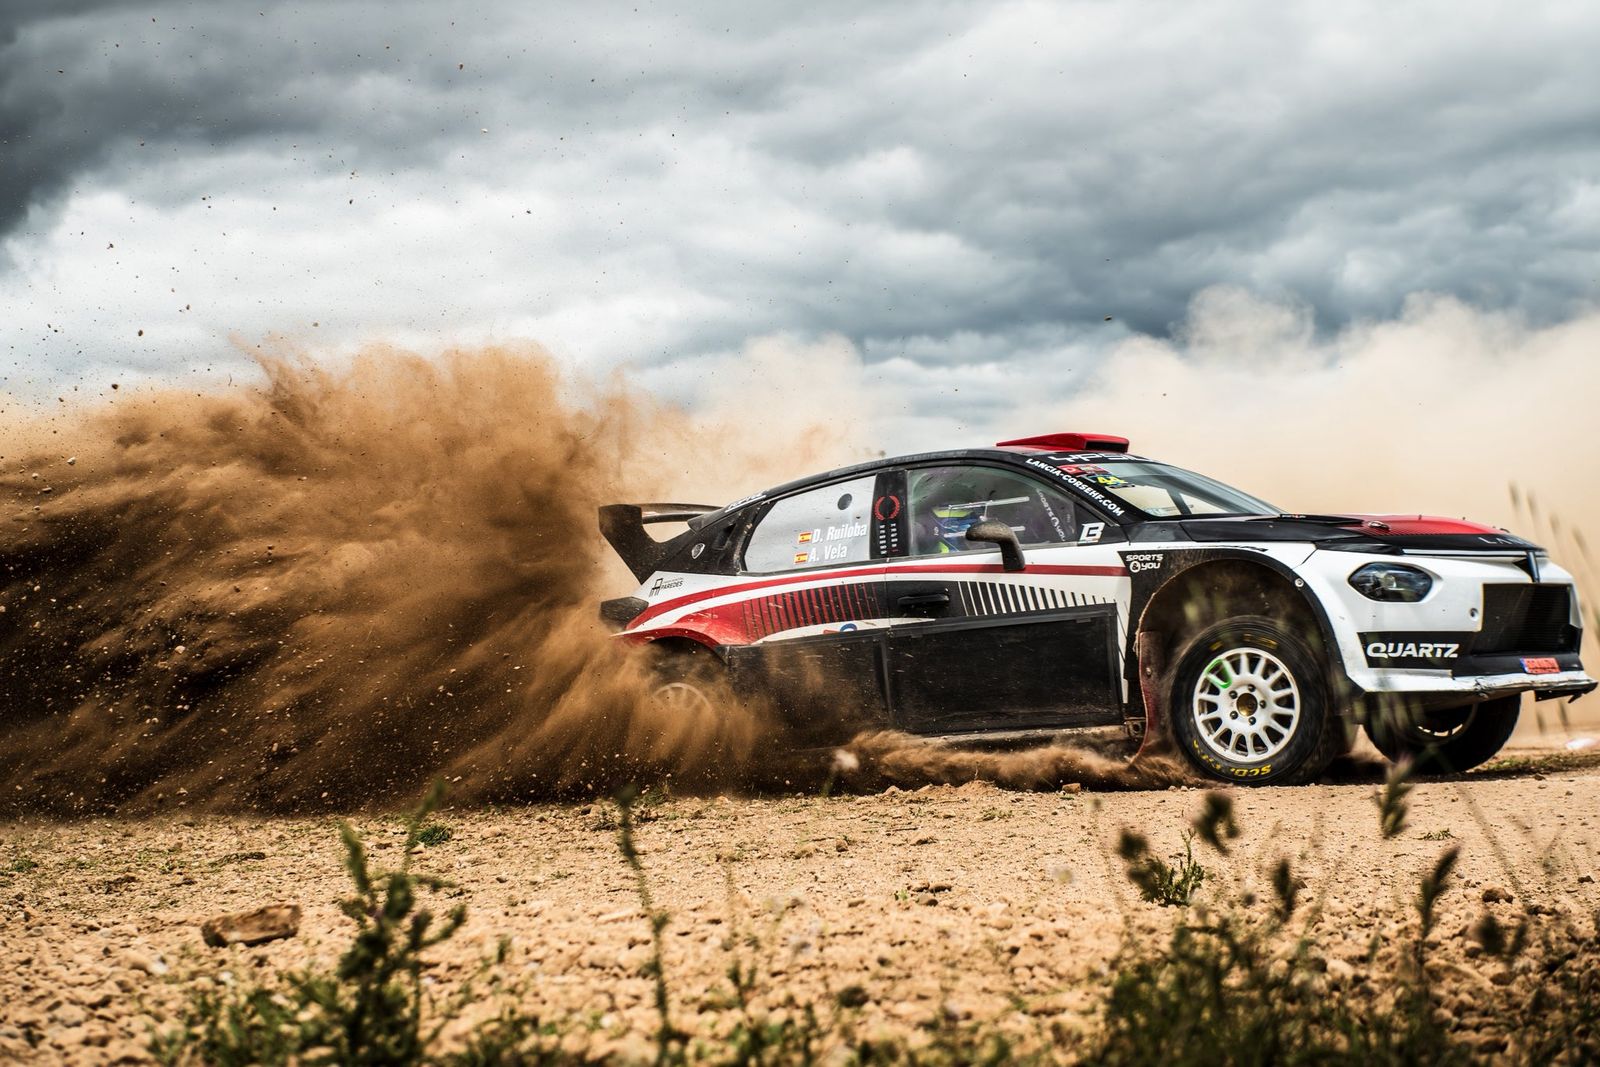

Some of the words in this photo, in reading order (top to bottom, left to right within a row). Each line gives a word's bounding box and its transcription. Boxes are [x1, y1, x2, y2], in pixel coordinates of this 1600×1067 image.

[1027, 459, 1125, 516] LANCIA-CORSEHF.COM
[812, 530, 822, 543] D.
[826, 522, 867, 540] Ruiloba
[808, 547, 819, 561] A.
[824, 544, 848, 560] Vela
[1126, 554, 1163, 562] SPORTS
[1141, 562, 1160, 570] YOU
[661, 580, 684, 590] PAREDES
[1366, 642, 1460, 659] QUARTZ
